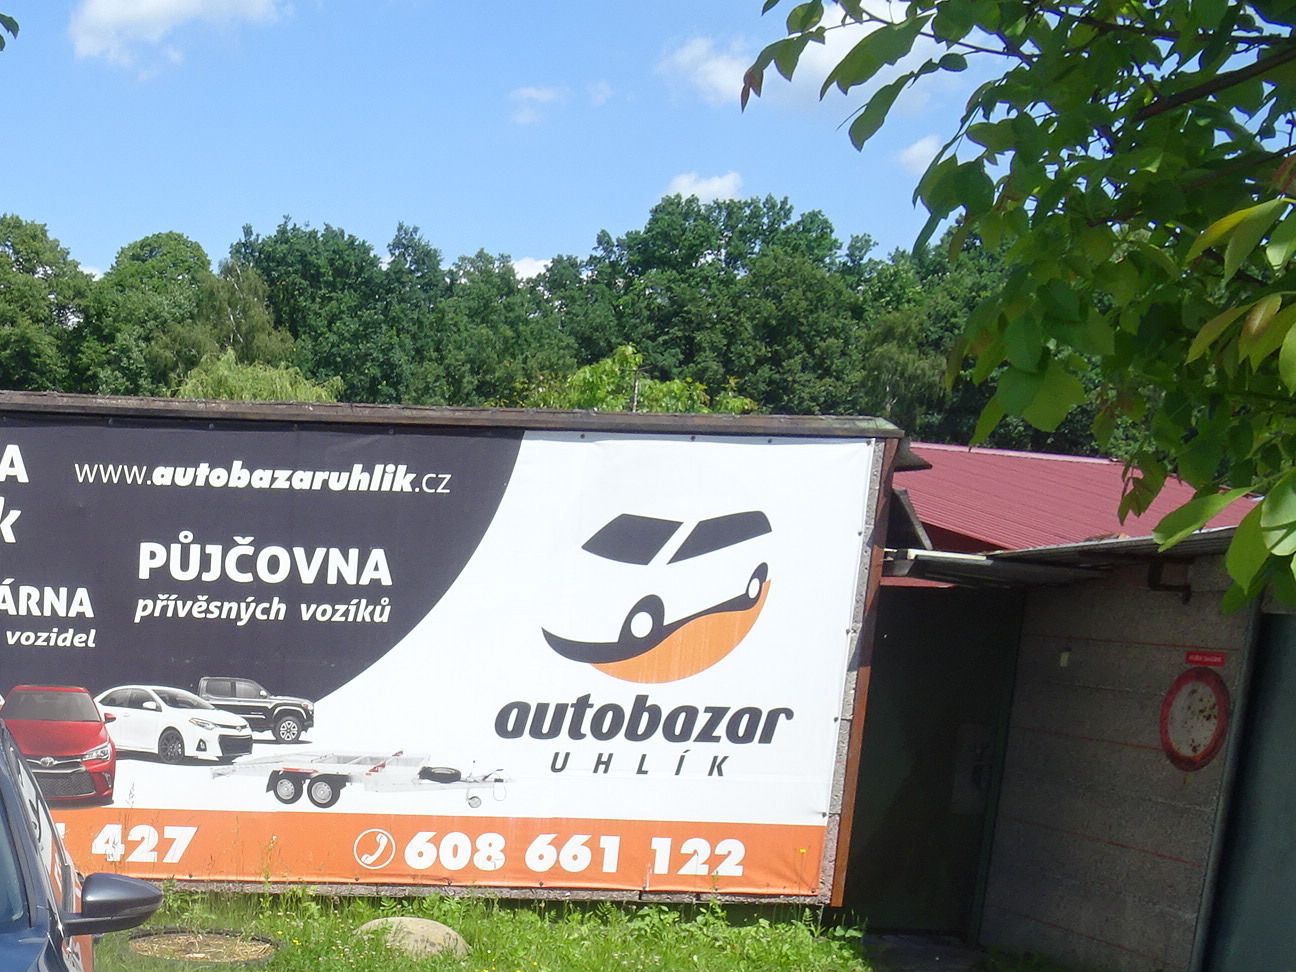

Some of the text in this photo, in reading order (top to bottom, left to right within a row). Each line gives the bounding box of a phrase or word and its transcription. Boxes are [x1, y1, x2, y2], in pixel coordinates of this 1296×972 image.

[74, 460, 452, 494] www.autobazaruhlik.cz
[138, 530, 393, 586] PŮJČOVNA
[133, 594, 392, 627] přívěsných vozíků
[5, 625, 97, 649] vozidel
[494, 693, 794, 744] autobazar
[550, 750, 729, 778] UHLÍK
[91, 823, 199, 864] 427
[404, 831, 746, 878] 608 661 122
